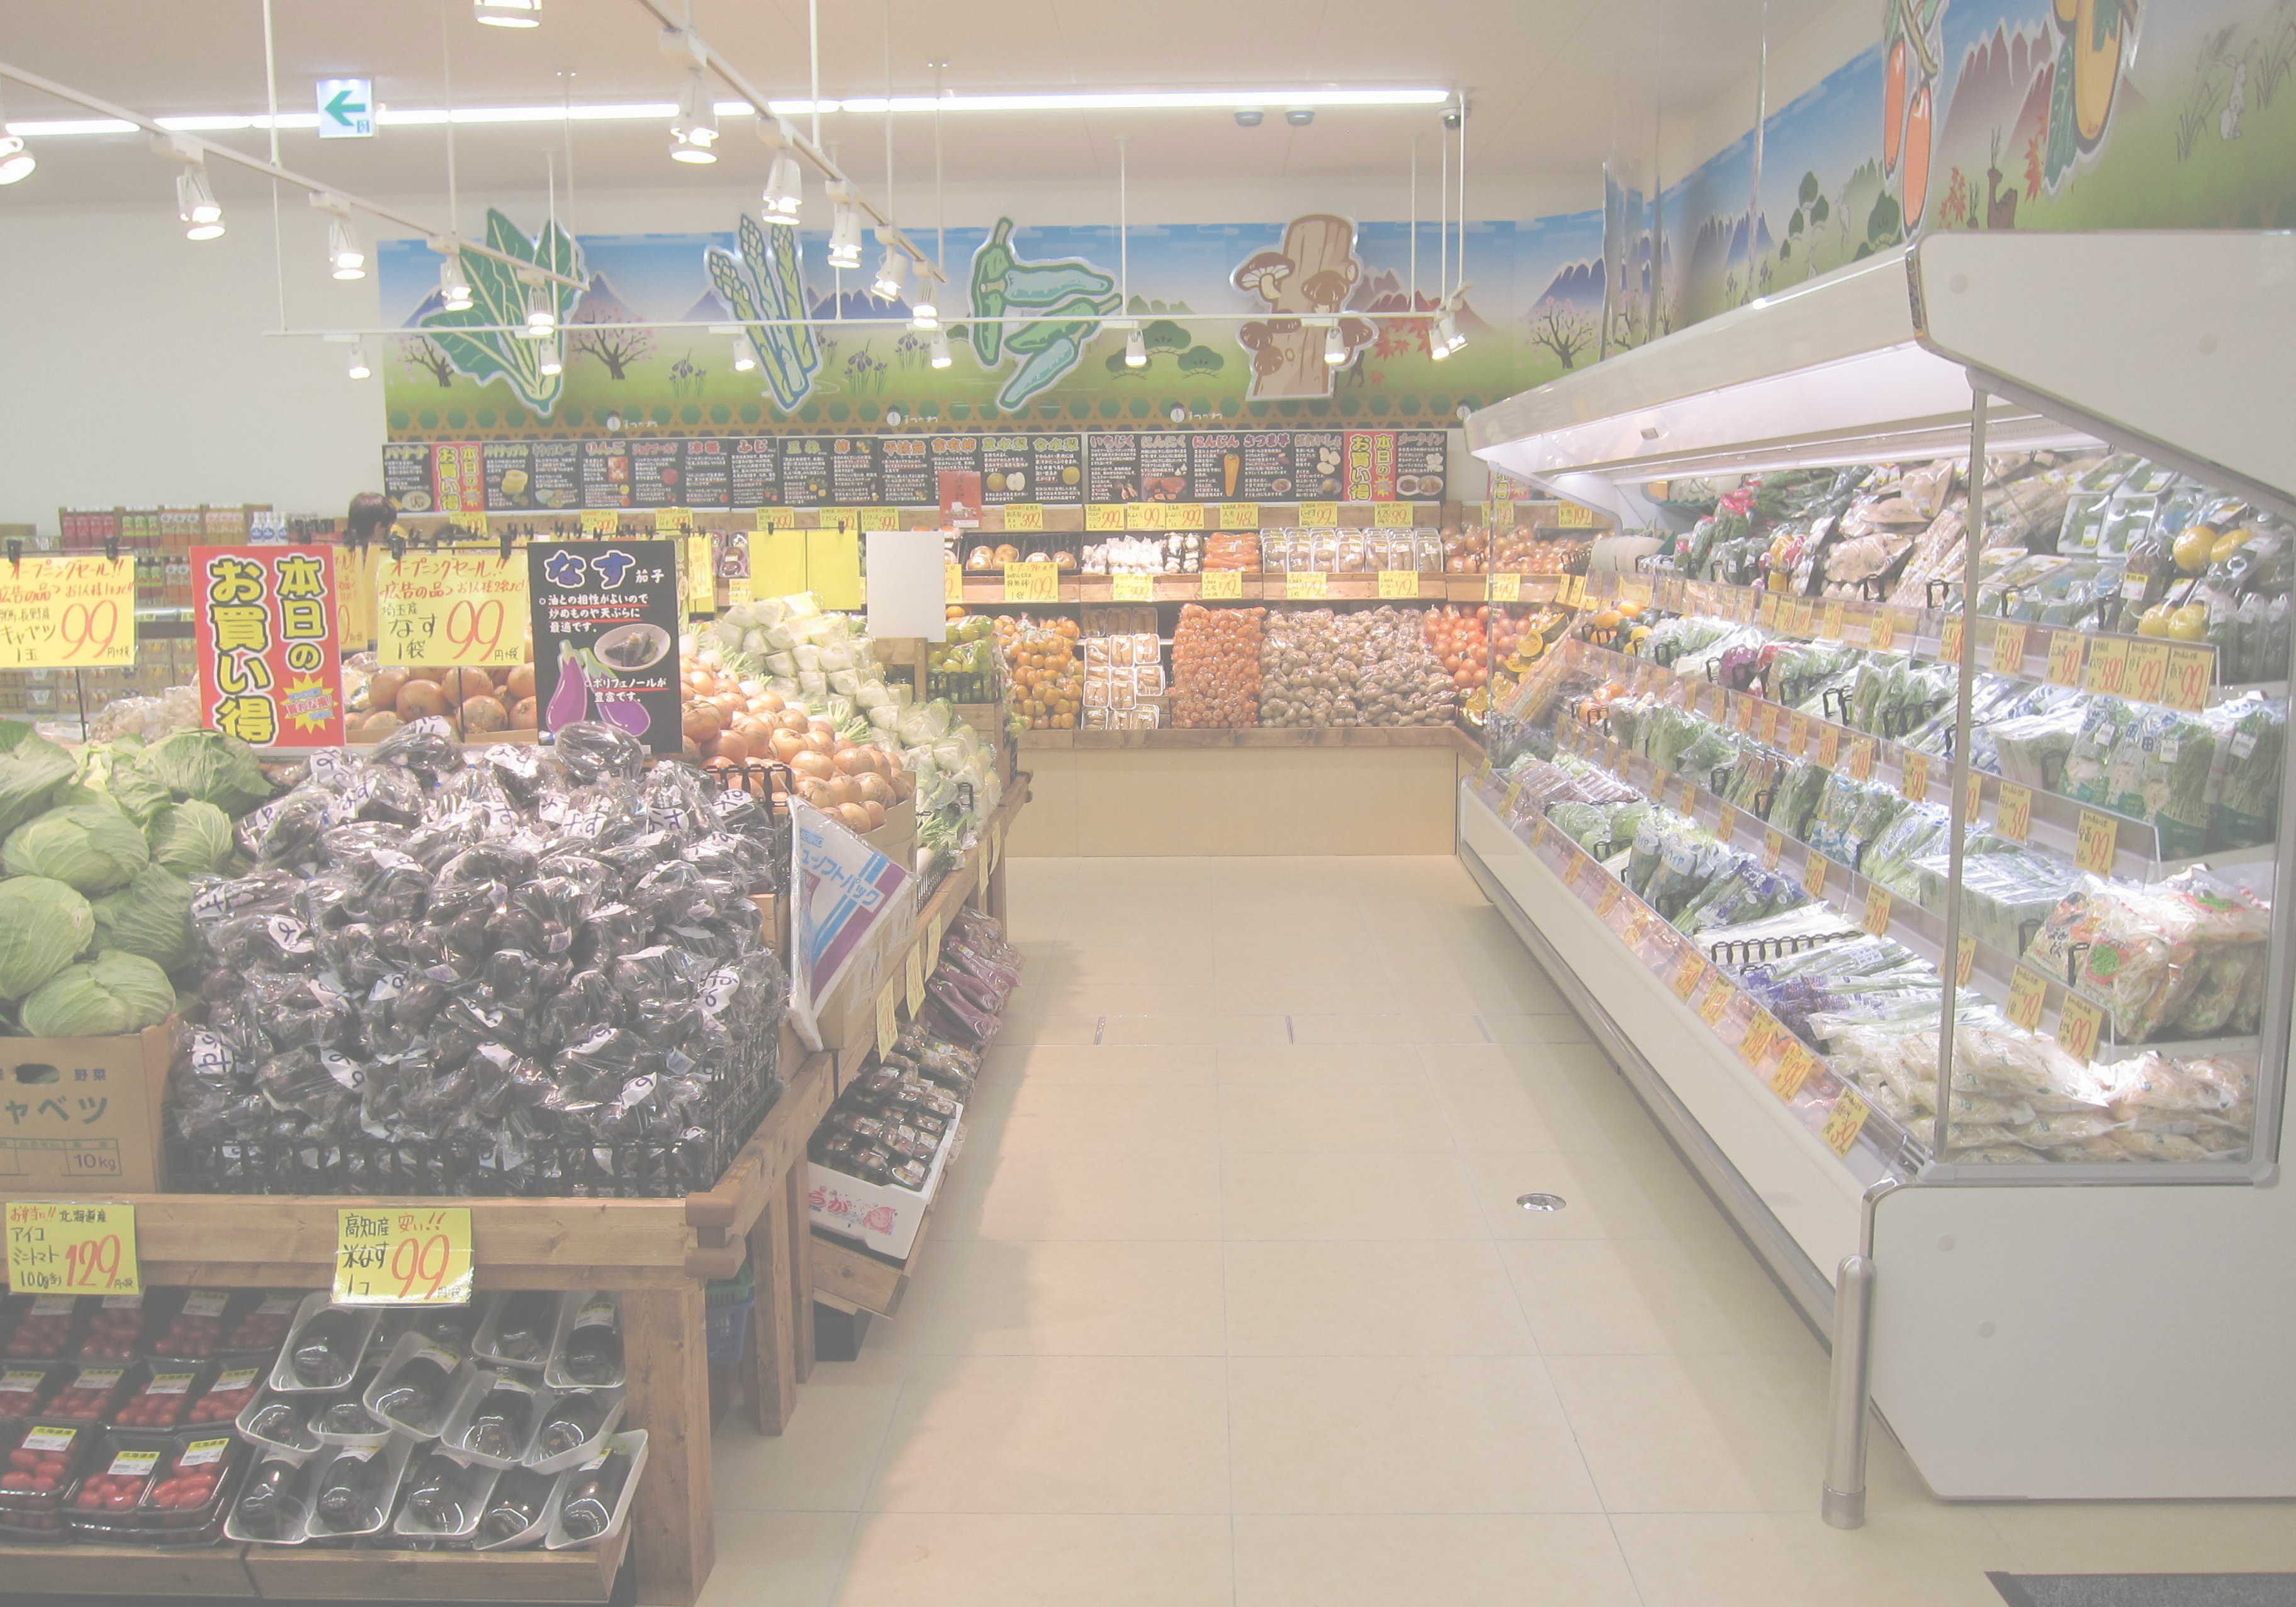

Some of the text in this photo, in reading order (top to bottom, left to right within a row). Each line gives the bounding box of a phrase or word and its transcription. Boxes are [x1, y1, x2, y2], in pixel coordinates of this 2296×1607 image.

[585, 441, 626, 456] りんご
[737, 439, 768, 453] ふじ
[1089, 435, 1135, 449] いちじく
[1140, 434, 1186, 449] にんにく
[1192, 434, 1239, 448] にんじん
[1243, 432, 1290, 448] さつま芋
[1397, 432, 1445, 446] メークイン
[461, 446, 477, 485] 本日の
[1374, 434, 1395, 476] 本日の
[439, 446, 459, 510] お買い得
[1349, 434, 1372, 502] お買い得
[1020, 512, 1041, 529] 399
[1144, 508, 1161, 529] 99
[1236, 510, 1254, 526] 48
[1316, 508, 1332, 526] 29
[1391, 510, 1407, 524] 39
[544, 550, 636, 590] なす
[635, 568, 665, 584] 茄子
[1030, 577, 1052, 599] 199
[275, 553, 327, 671] 本日の
[382, 601, 418, 616] 埼玉産
[548, 607, 641, 619] 炒めものや天ぷらに
[1, 624, 56, 645] キャベツ
[61, 599, 118, 660] 99
[388, 612, 438, 638] なす
[446, 599, 504, 662] 99
[549, 621, 598, 633] 最適です。
[17, 648, 38, 663] 1玉
[207, 555, 279, 745] お買い得
[398, 638, 426, 660] 1袋
[2060, 650, 2079, 684] 99
[592, 677, 667, 689] ポリフェノールが
[2139, 660, 2162, 701] 99
[2180, 664, 2204, 709] 99
[594, 691, 641, 703] 豊富です。
[2089, 830, 2110, 871] 99
[800, 849, 881, 906] ューソフトパック
[2068, 1018, 2092, 1057] 99
[74, 1068, 106, 1081] 野菜
[59, 1209, 108, 1222] 北海道産
[345, 1212, 390, 1239] 高知産
[398, 1211, 446, 1234] 安い!!
[11, 1227, 45, 1243] アイコ
[13, 1244, 60, 1265] ミニトマト
[65, 1234, 121, 1288] 129
[342, 1241, 390, 1270] 米なす
[391, 1234, 450, 1300] 99
[347, 1273, 370, 1298] 1コ
